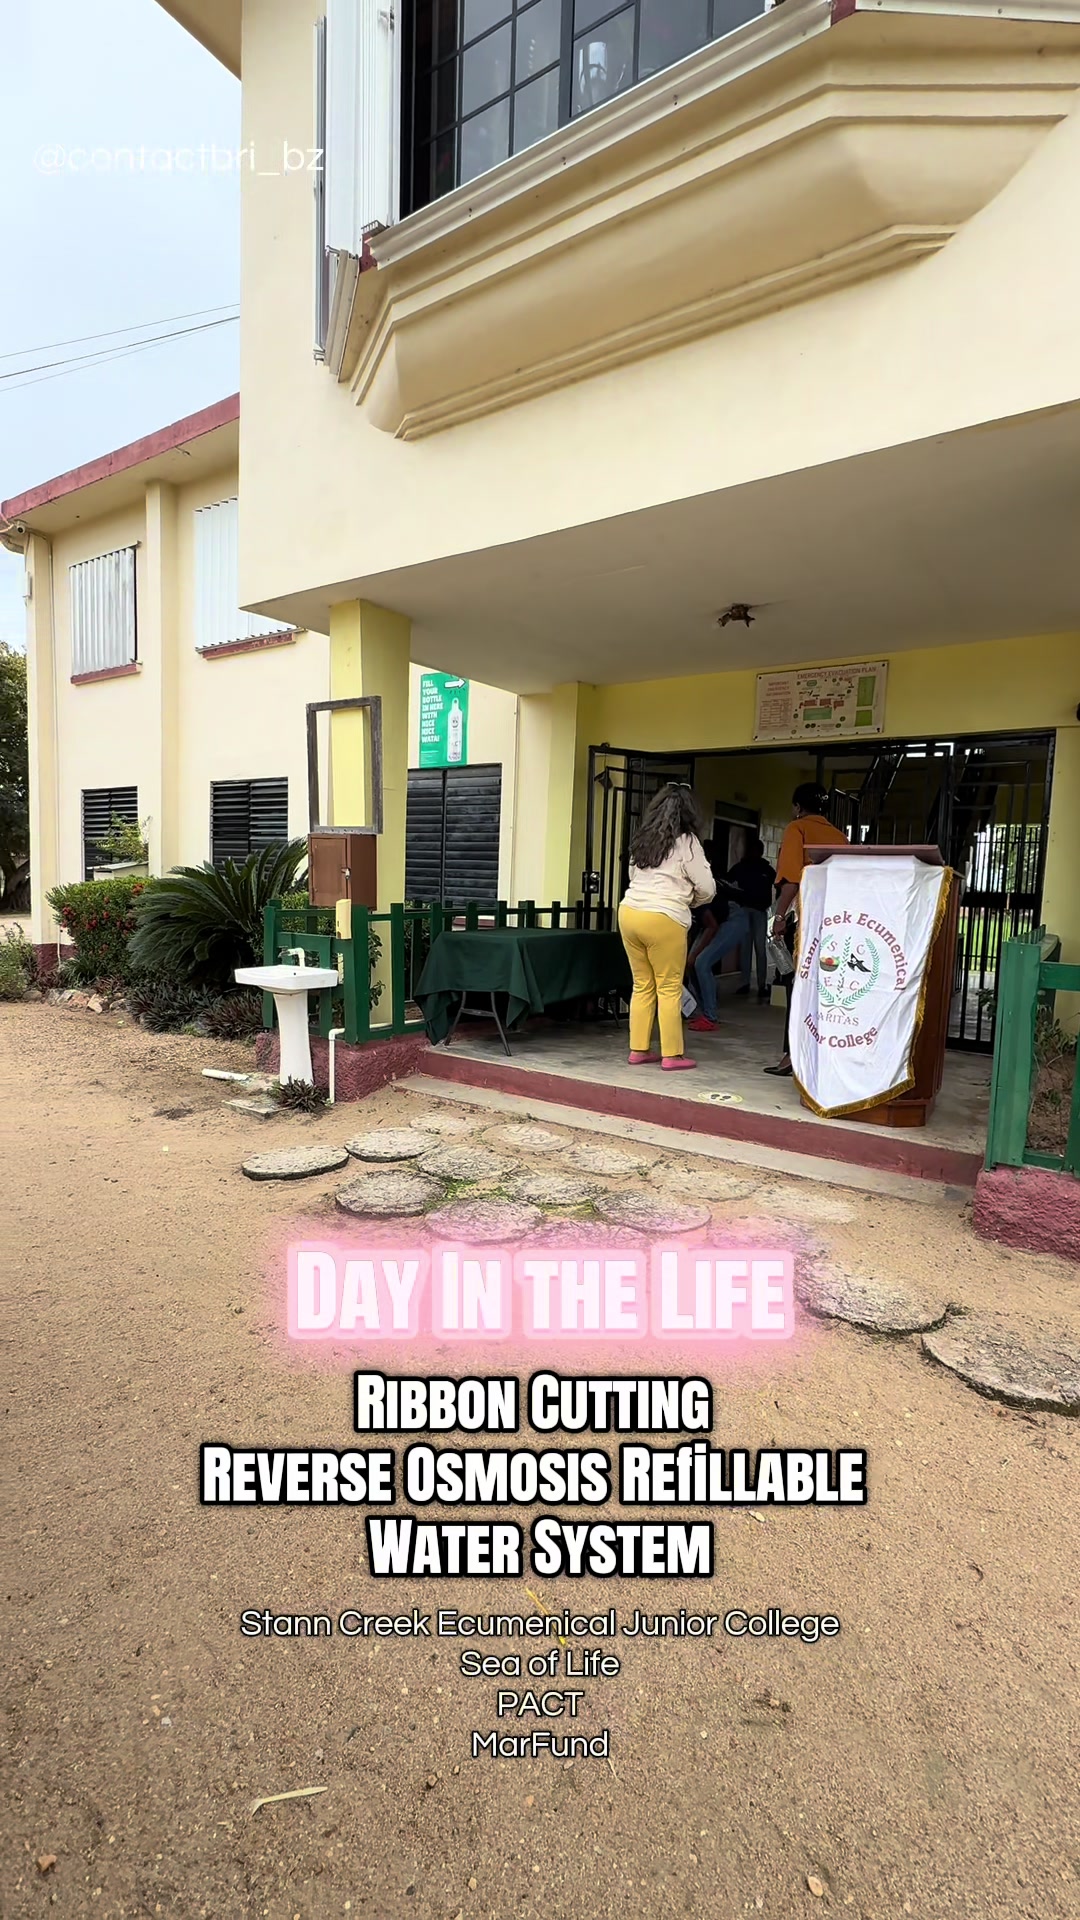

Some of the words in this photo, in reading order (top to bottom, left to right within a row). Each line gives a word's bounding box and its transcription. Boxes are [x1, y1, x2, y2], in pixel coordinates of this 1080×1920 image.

[797, 671, 828, 679] EMERGENCY
[828, 668, 860, 677] EVACUATION
[422, 680, 434, 688] FILL
[422, 687, 439, 695] YOUR
[422, 695, 442, 704] BOTTLE
[422, 704, 429, 712] IN
[429, 703, 443, 711] HERE
[422, 711, 438, 719] WITH
[421, 719, 435, 727] NICE
[421, 727, 435, 735] NICE
[800, 937, 820, 980] Stann
[856, 912, 909, 992] Ecumenical
[827, 941, 838, 952] S
[856, 944, 866, 955] C
[816, 1012, 860, 1027] ARITAS
[828, 1026, 878, 1048] College
